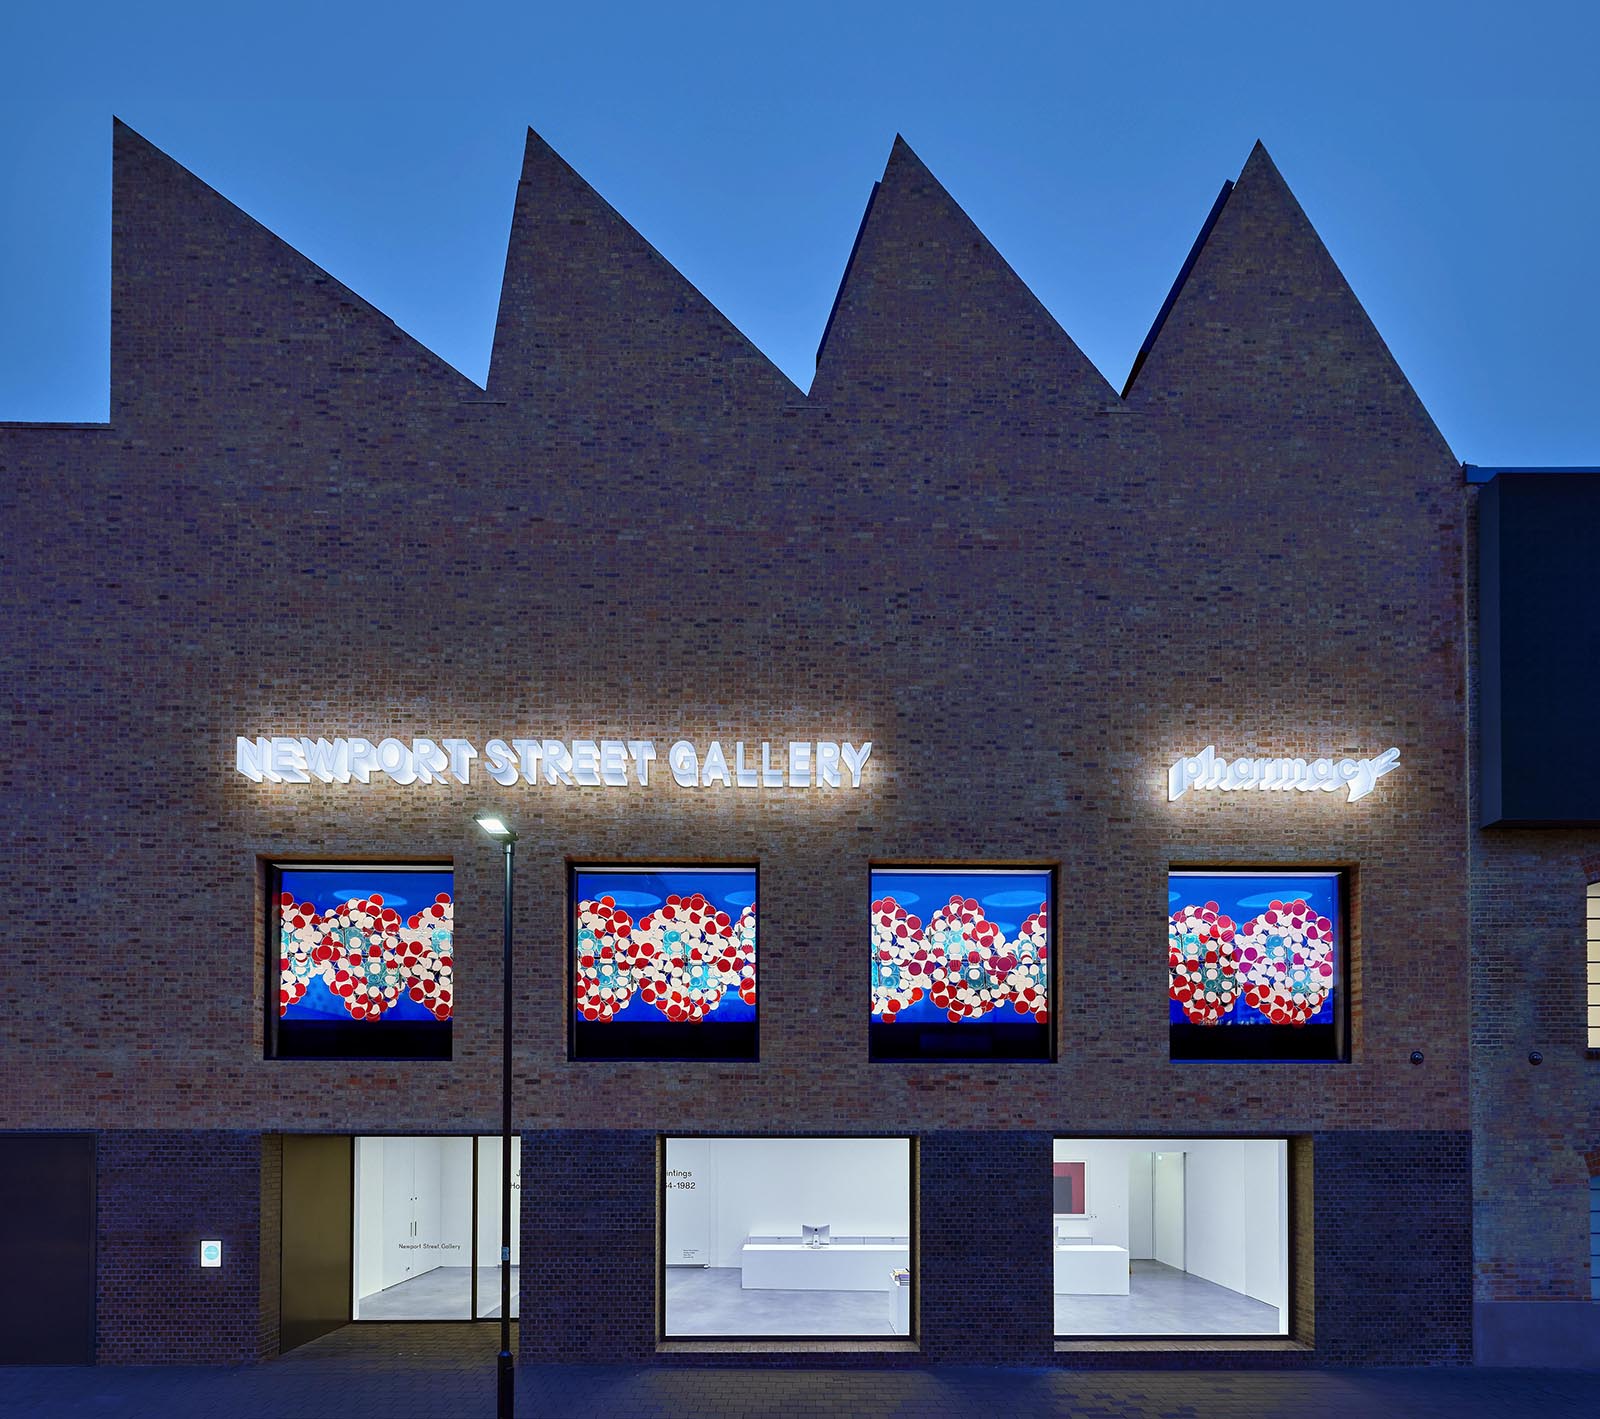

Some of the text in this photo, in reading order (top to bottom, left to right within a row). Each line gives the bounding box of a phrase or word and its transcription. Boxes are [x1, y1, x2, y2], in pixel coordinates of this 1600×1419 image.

[236, 736, 873, 787] NEWPORT STREET GALLERY
[441, 1243, 461, 1251] Gallery
